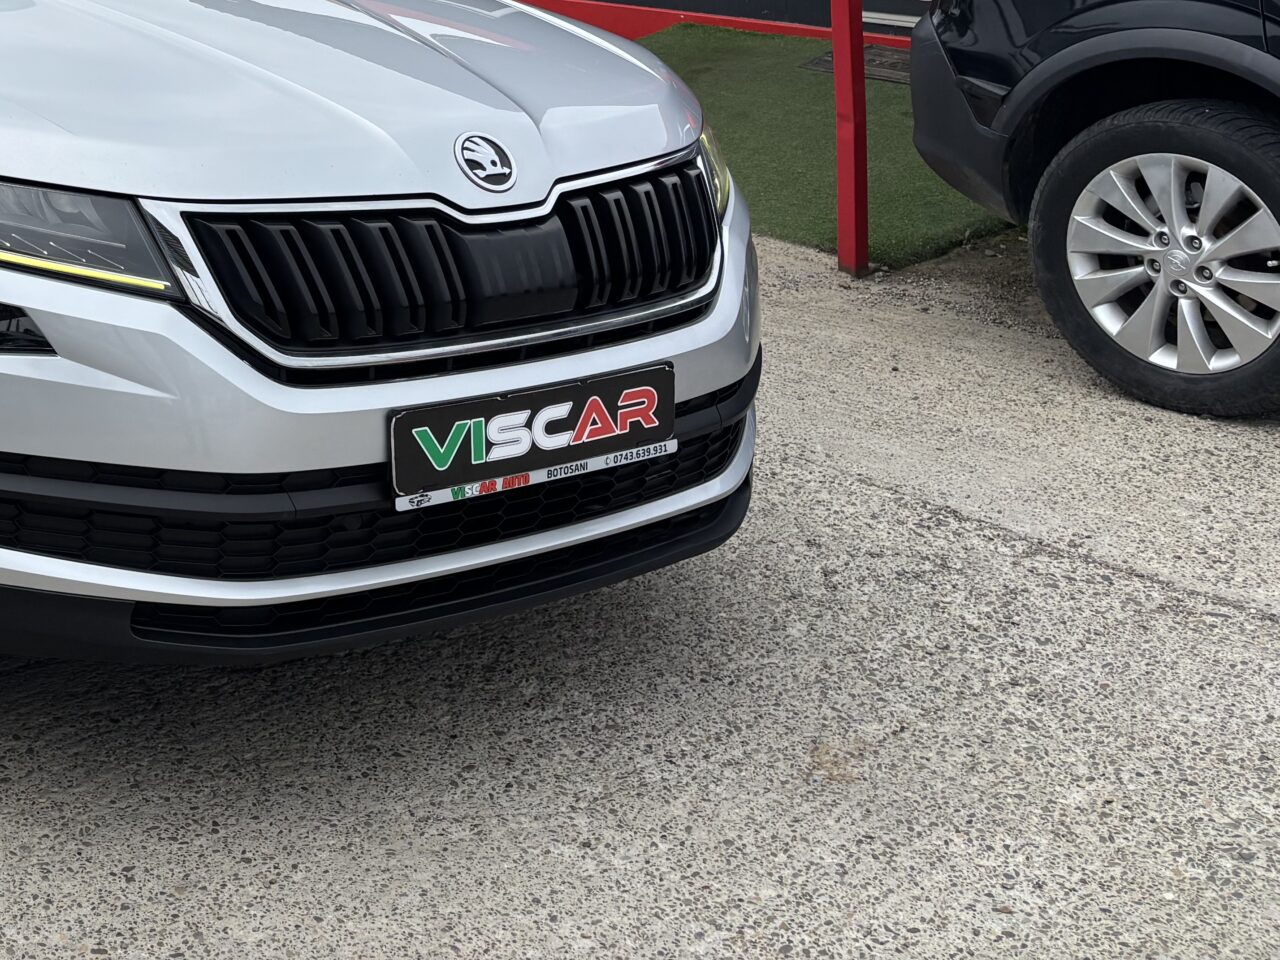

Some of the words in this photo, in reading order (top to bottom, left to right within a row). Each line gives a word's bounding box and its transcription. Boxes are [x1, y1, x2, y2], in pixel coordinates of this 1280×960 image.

[412, 386, 659, 471] VISCAR
[451, 479, 497, 501] VISCAR
[502, 472, 530, 490] AUTO
[546, 461, 589, 479] BOTOSANI
[613, 443, 669, 465] 0743.639.931
